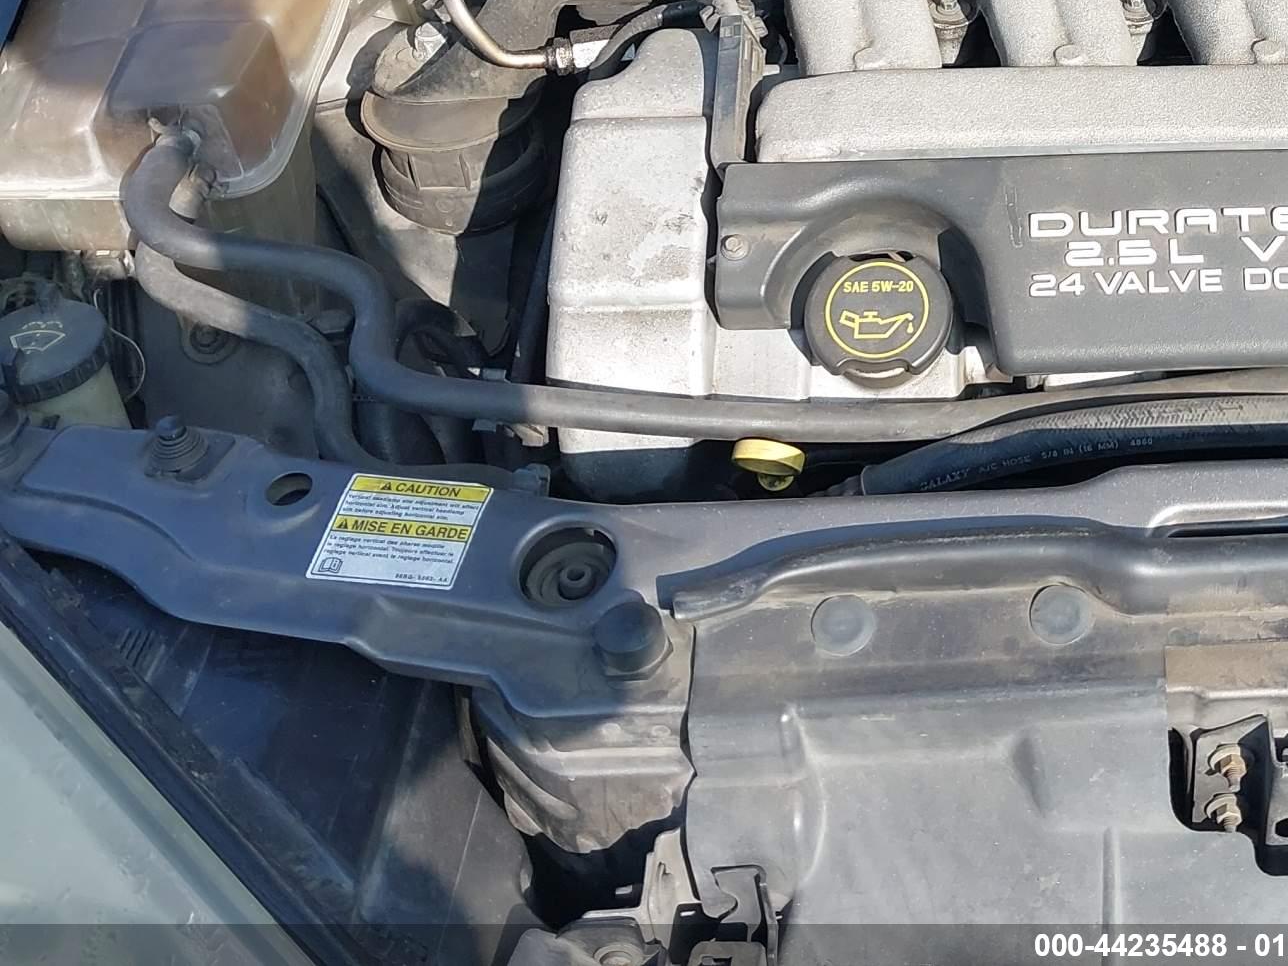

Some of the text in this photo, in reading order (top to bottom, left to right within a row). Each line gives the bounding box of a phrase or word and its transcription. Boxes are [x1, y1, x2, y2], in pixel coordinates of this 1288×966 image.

[842, 280, 915, 296] SAE 5W-20
[1029, 272, 1086, 298] 24
[1096, 267, 1224, 294] VALVE
[395, 481, 462, 498] CAUTION
[351, 518, 469, 541] MISE EN GARDE
